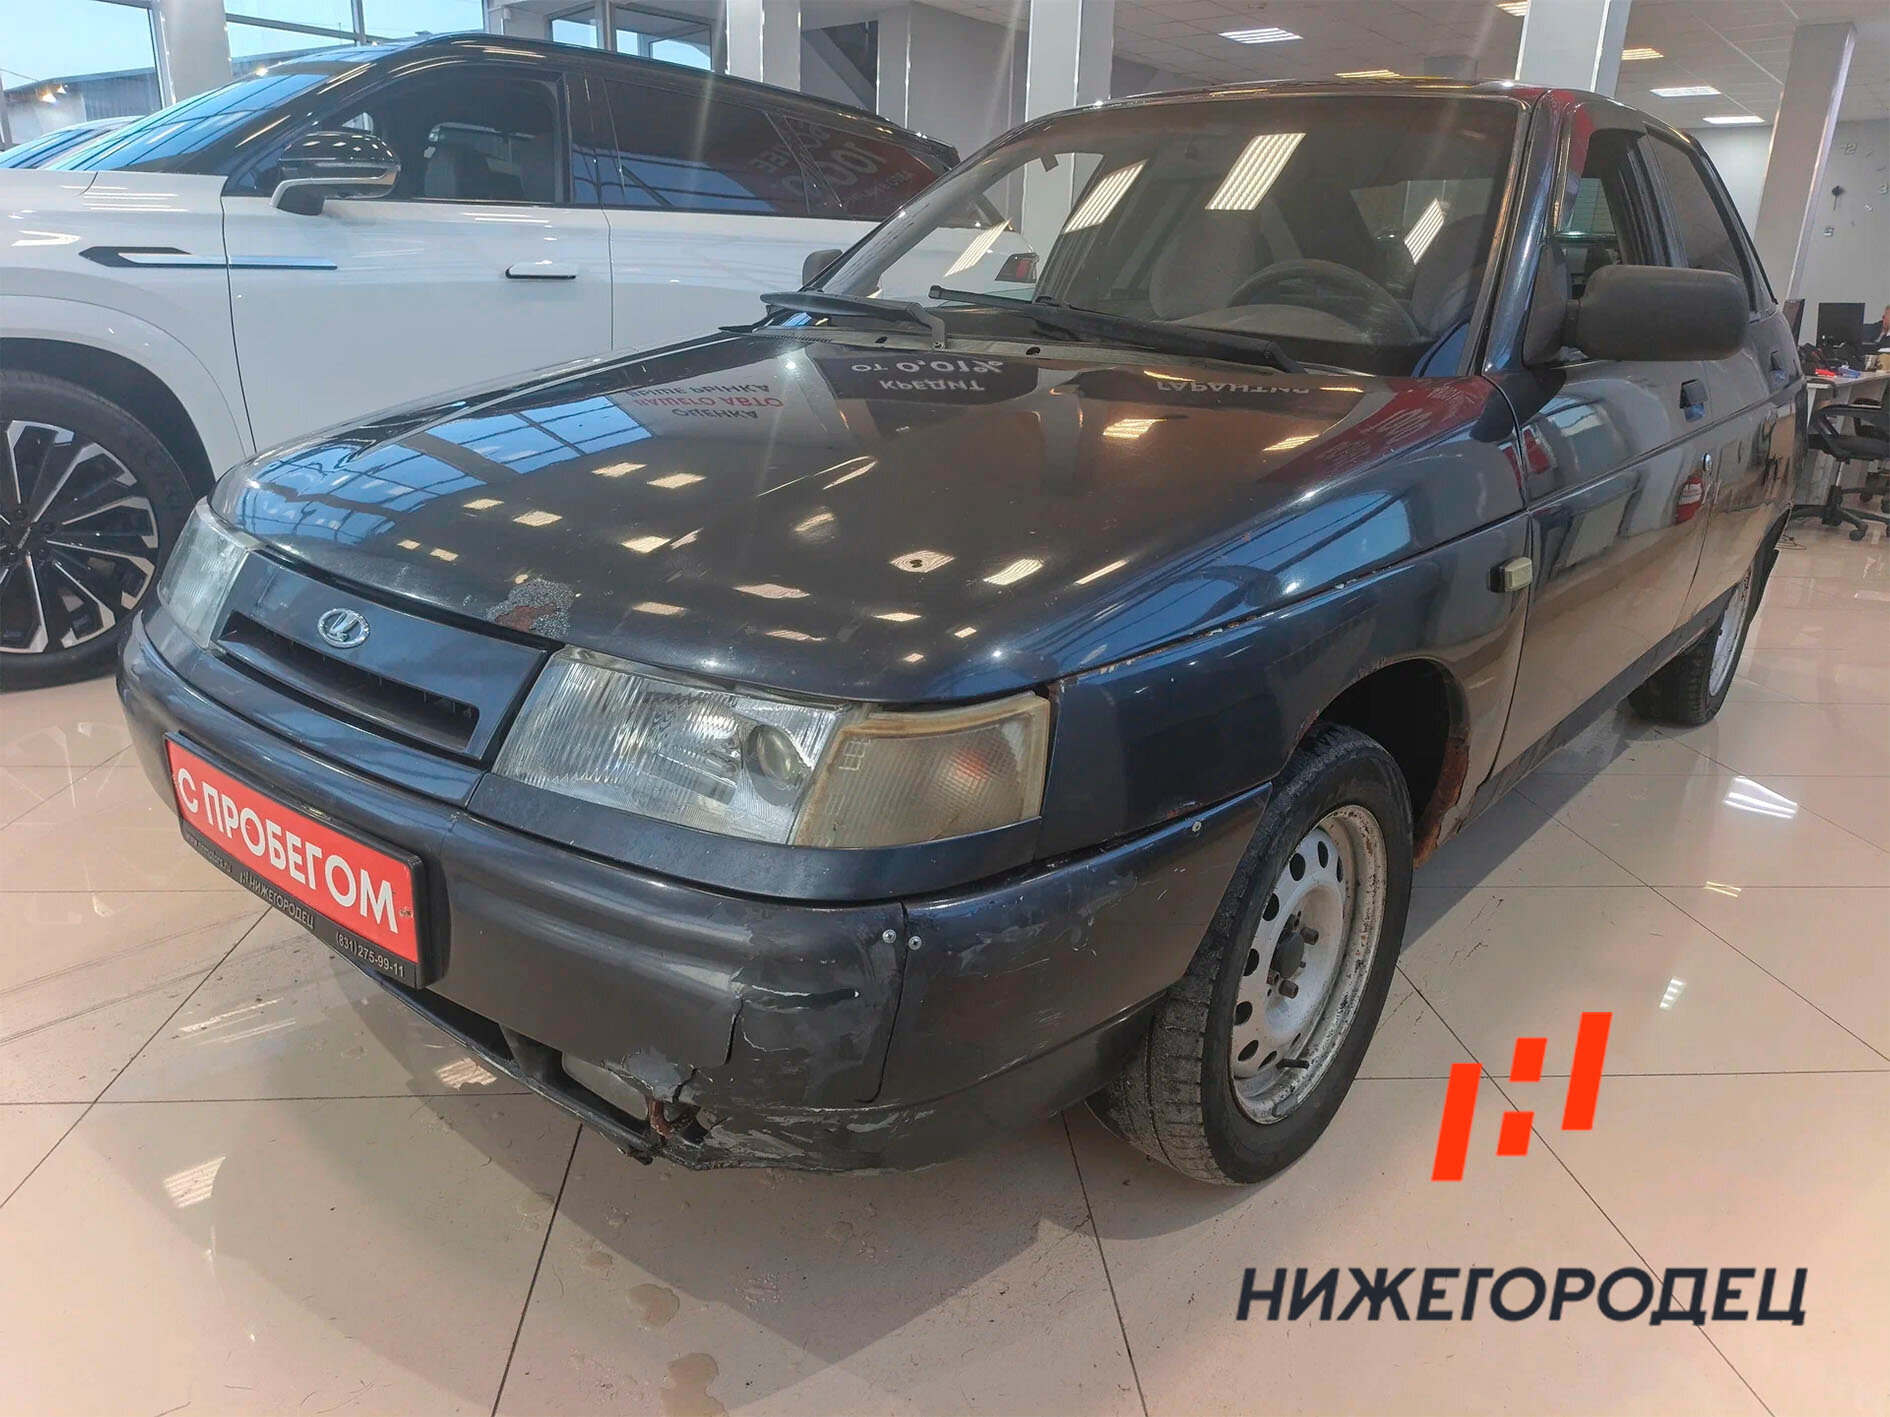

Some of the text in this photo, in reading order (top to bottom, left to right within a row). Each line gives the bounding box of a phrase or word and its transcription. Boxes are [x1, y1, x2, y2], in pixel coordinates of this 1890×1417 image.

[177, 767, 399, 935] С ПРОБЕГОМ
[249, 876, 315, 930] НИЖЕГОРОДЕЦ
